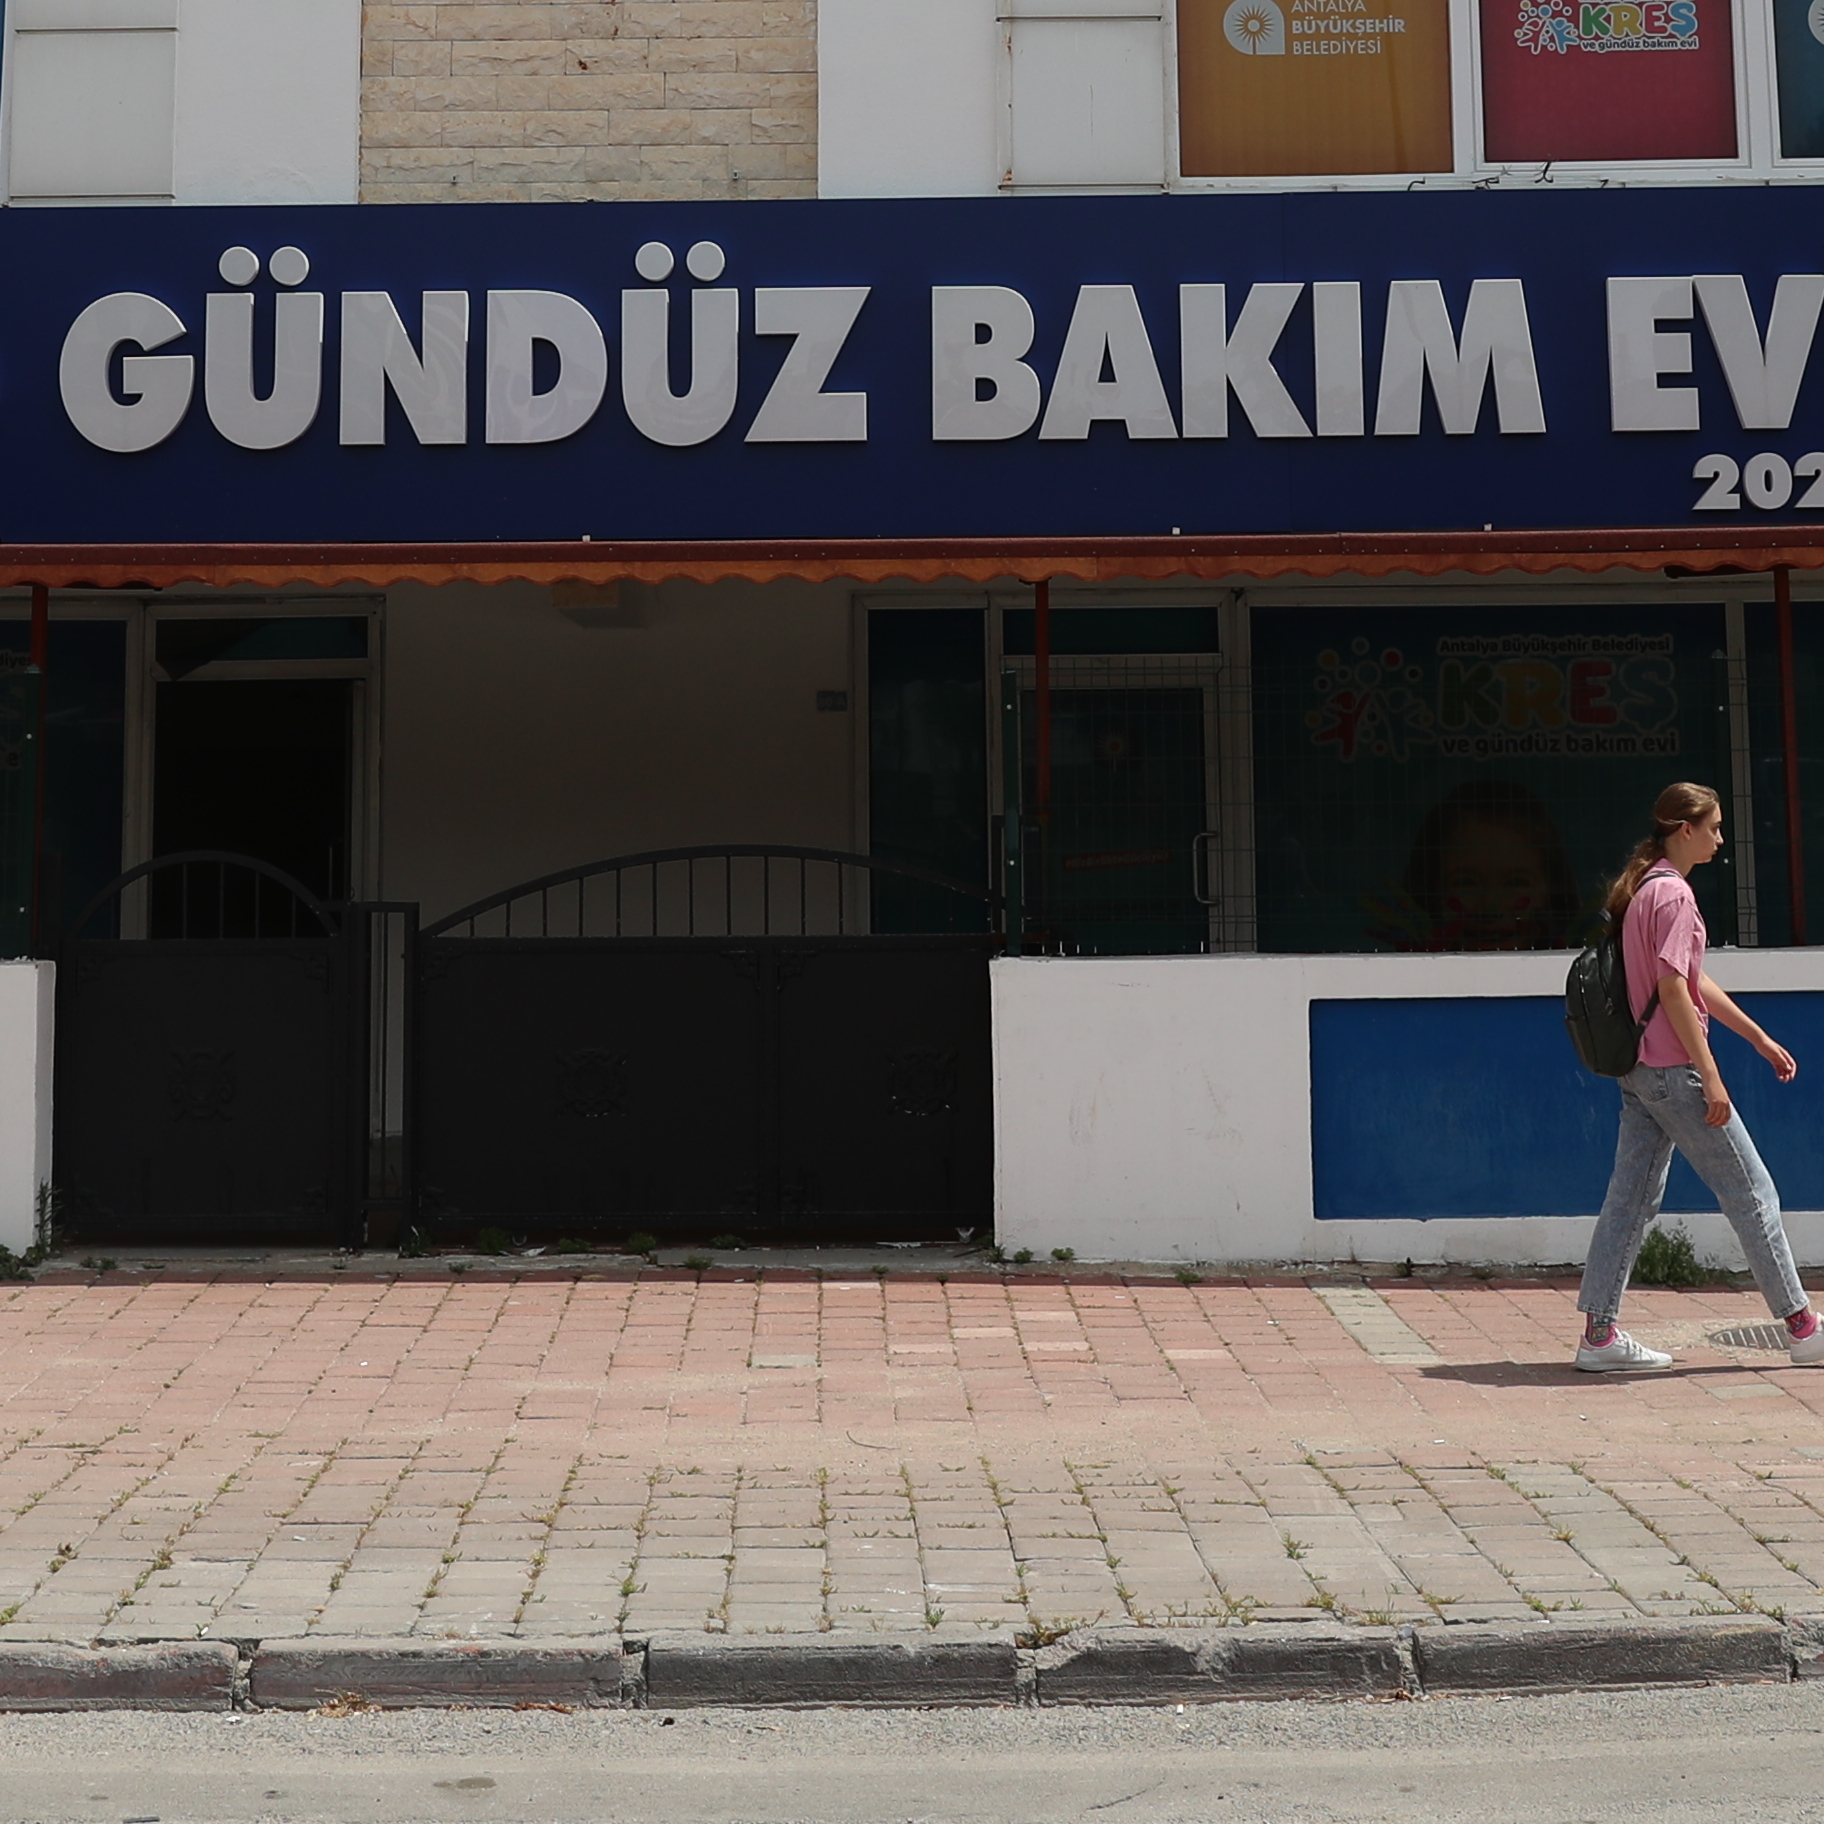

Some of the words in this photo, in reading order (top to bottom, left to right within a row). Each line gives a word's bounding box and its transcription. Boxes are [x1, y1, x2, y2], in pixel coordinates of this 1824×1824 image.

[1291, 0, 1366, 13] ANTALYA
[1292, 15, 1406, 36] BÜYÜKŞEHİR
[1580, 2, 1697, 37] KREŞ
[1293, 37, 1381, 55] BELEDİYESİ
[1583, 41, 1596, 49] ve
[1599, 39, 1640, 50] gündüz
[1643, 38, 1678, 48] bakım
[1680, 38, 1697, 47] evi
[59, 240, 870, 451] GÜNDÜZ
[932, 278, 1547, 442] BAKIM
[1440, 640, 1498, 654] Antalya
[1503, 638, 1588, 654] Büyükşehir
[1592, 637, 1669, 653] Belediyesi
[1440, 658, 1677, 733] KREŞ
[1443, 738, 1470, 753] ve
[1476, 733, 1560, 756] gündüz
[1566, 734, 1636, 752] bakım
[1642, 732, 1676, 752] evi
